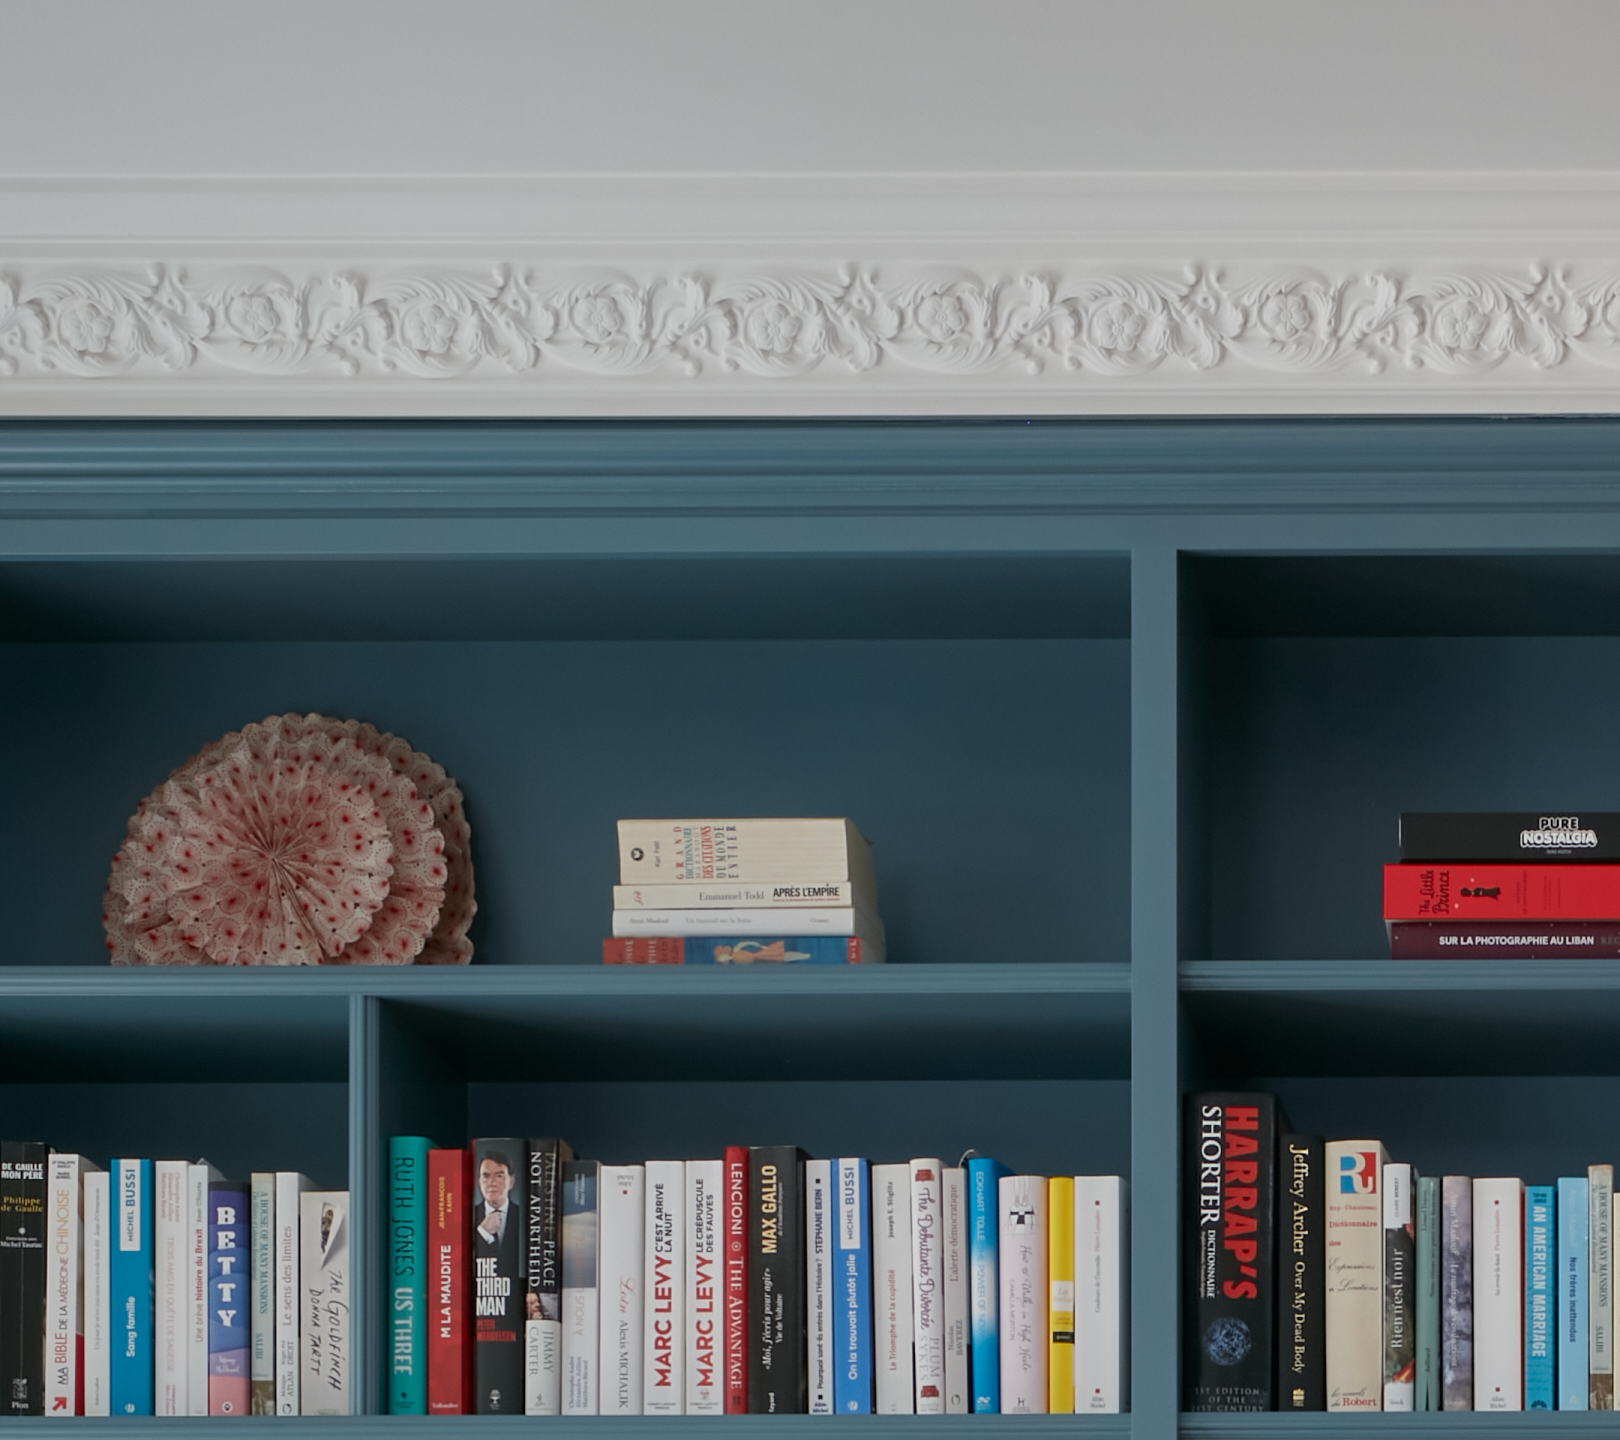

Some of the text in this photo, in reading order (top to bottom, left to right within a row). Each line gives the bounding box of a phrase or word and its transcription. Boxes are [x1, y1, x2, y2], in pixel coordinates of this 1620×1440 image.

[1520, 830, 1598, 848] NOSTALGIA
[1539, 818, 1578, 830] PURE
[773, 886, 840, 898] APRÈS L'EMPIRE
[1439, 936, 1594, 945] SUR LA PHOTOGRAPHIE AU LIBAN
[2, 1163, 44, 1171] DE GAULLE
[2, 1169, 44, 1180] MON PÈRE
[529, 1151, 542, 1287] NOT APARTHEID
[731, 1163, 742, 1235] LENCIONI
[761, 1165, 777, 1253] MAX GALLO
[1200, 1105, 1222, 1298] SHORTER DICTIONNAIRE
[1223, 1106, 1258, 1299] HARRAP'S
[217, 1207, 236, 1327] BETTY
[330, 1270, 343, 1293] The
[392, 1157, 414, 1375] RUTH JONES US THREE
[476, 1258, 497, 1277] THE
[476, 1277, 510, 1297] THIRD
[654, 1254, 672, 1313] LEVY
[1289, 1144, 1308, 1373] Jeffrey Archer Over My Dead Body
[1532, 1206, 1546, 1357] AN AMERICAN MARRIAGE
[309, 1288, 323, 1375] DONNA TARTT
[476, 1296, 505, 1316] MAN
[654, 1320, 672, 1386] MARC
